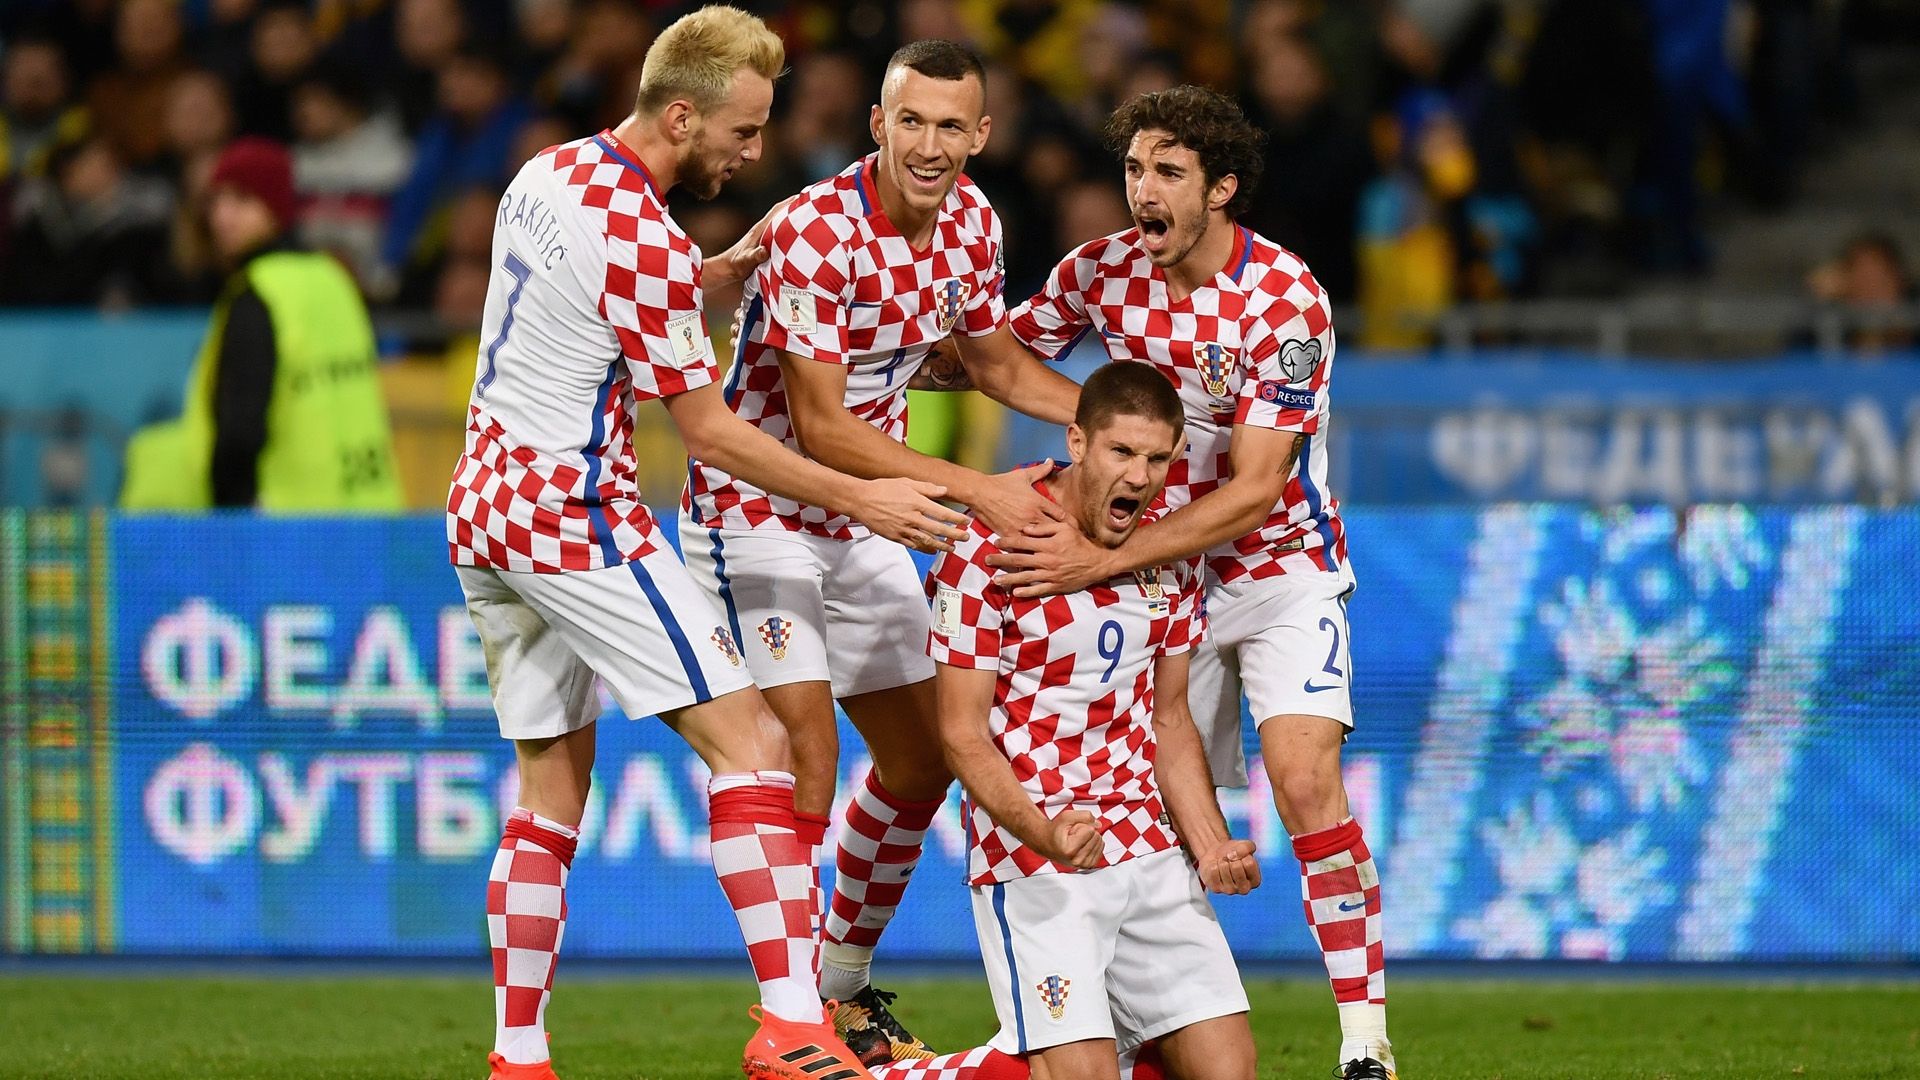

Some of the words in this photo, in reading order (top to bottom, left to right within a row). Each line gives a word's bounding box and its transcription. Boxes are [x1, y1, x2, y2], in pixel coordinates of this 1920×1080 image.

[499, 193, 568, 272] RAKITIĆ
[477, 248, 533, 399] 7
[872, 348, 907, 387] 4
[1277, 390, 1316, 406] RESPECT
[142, 598, 491, 730] ФЕДЕ
[1098, 620, 1124, 683] 9
[1319, 617, 1342, 678] 2
